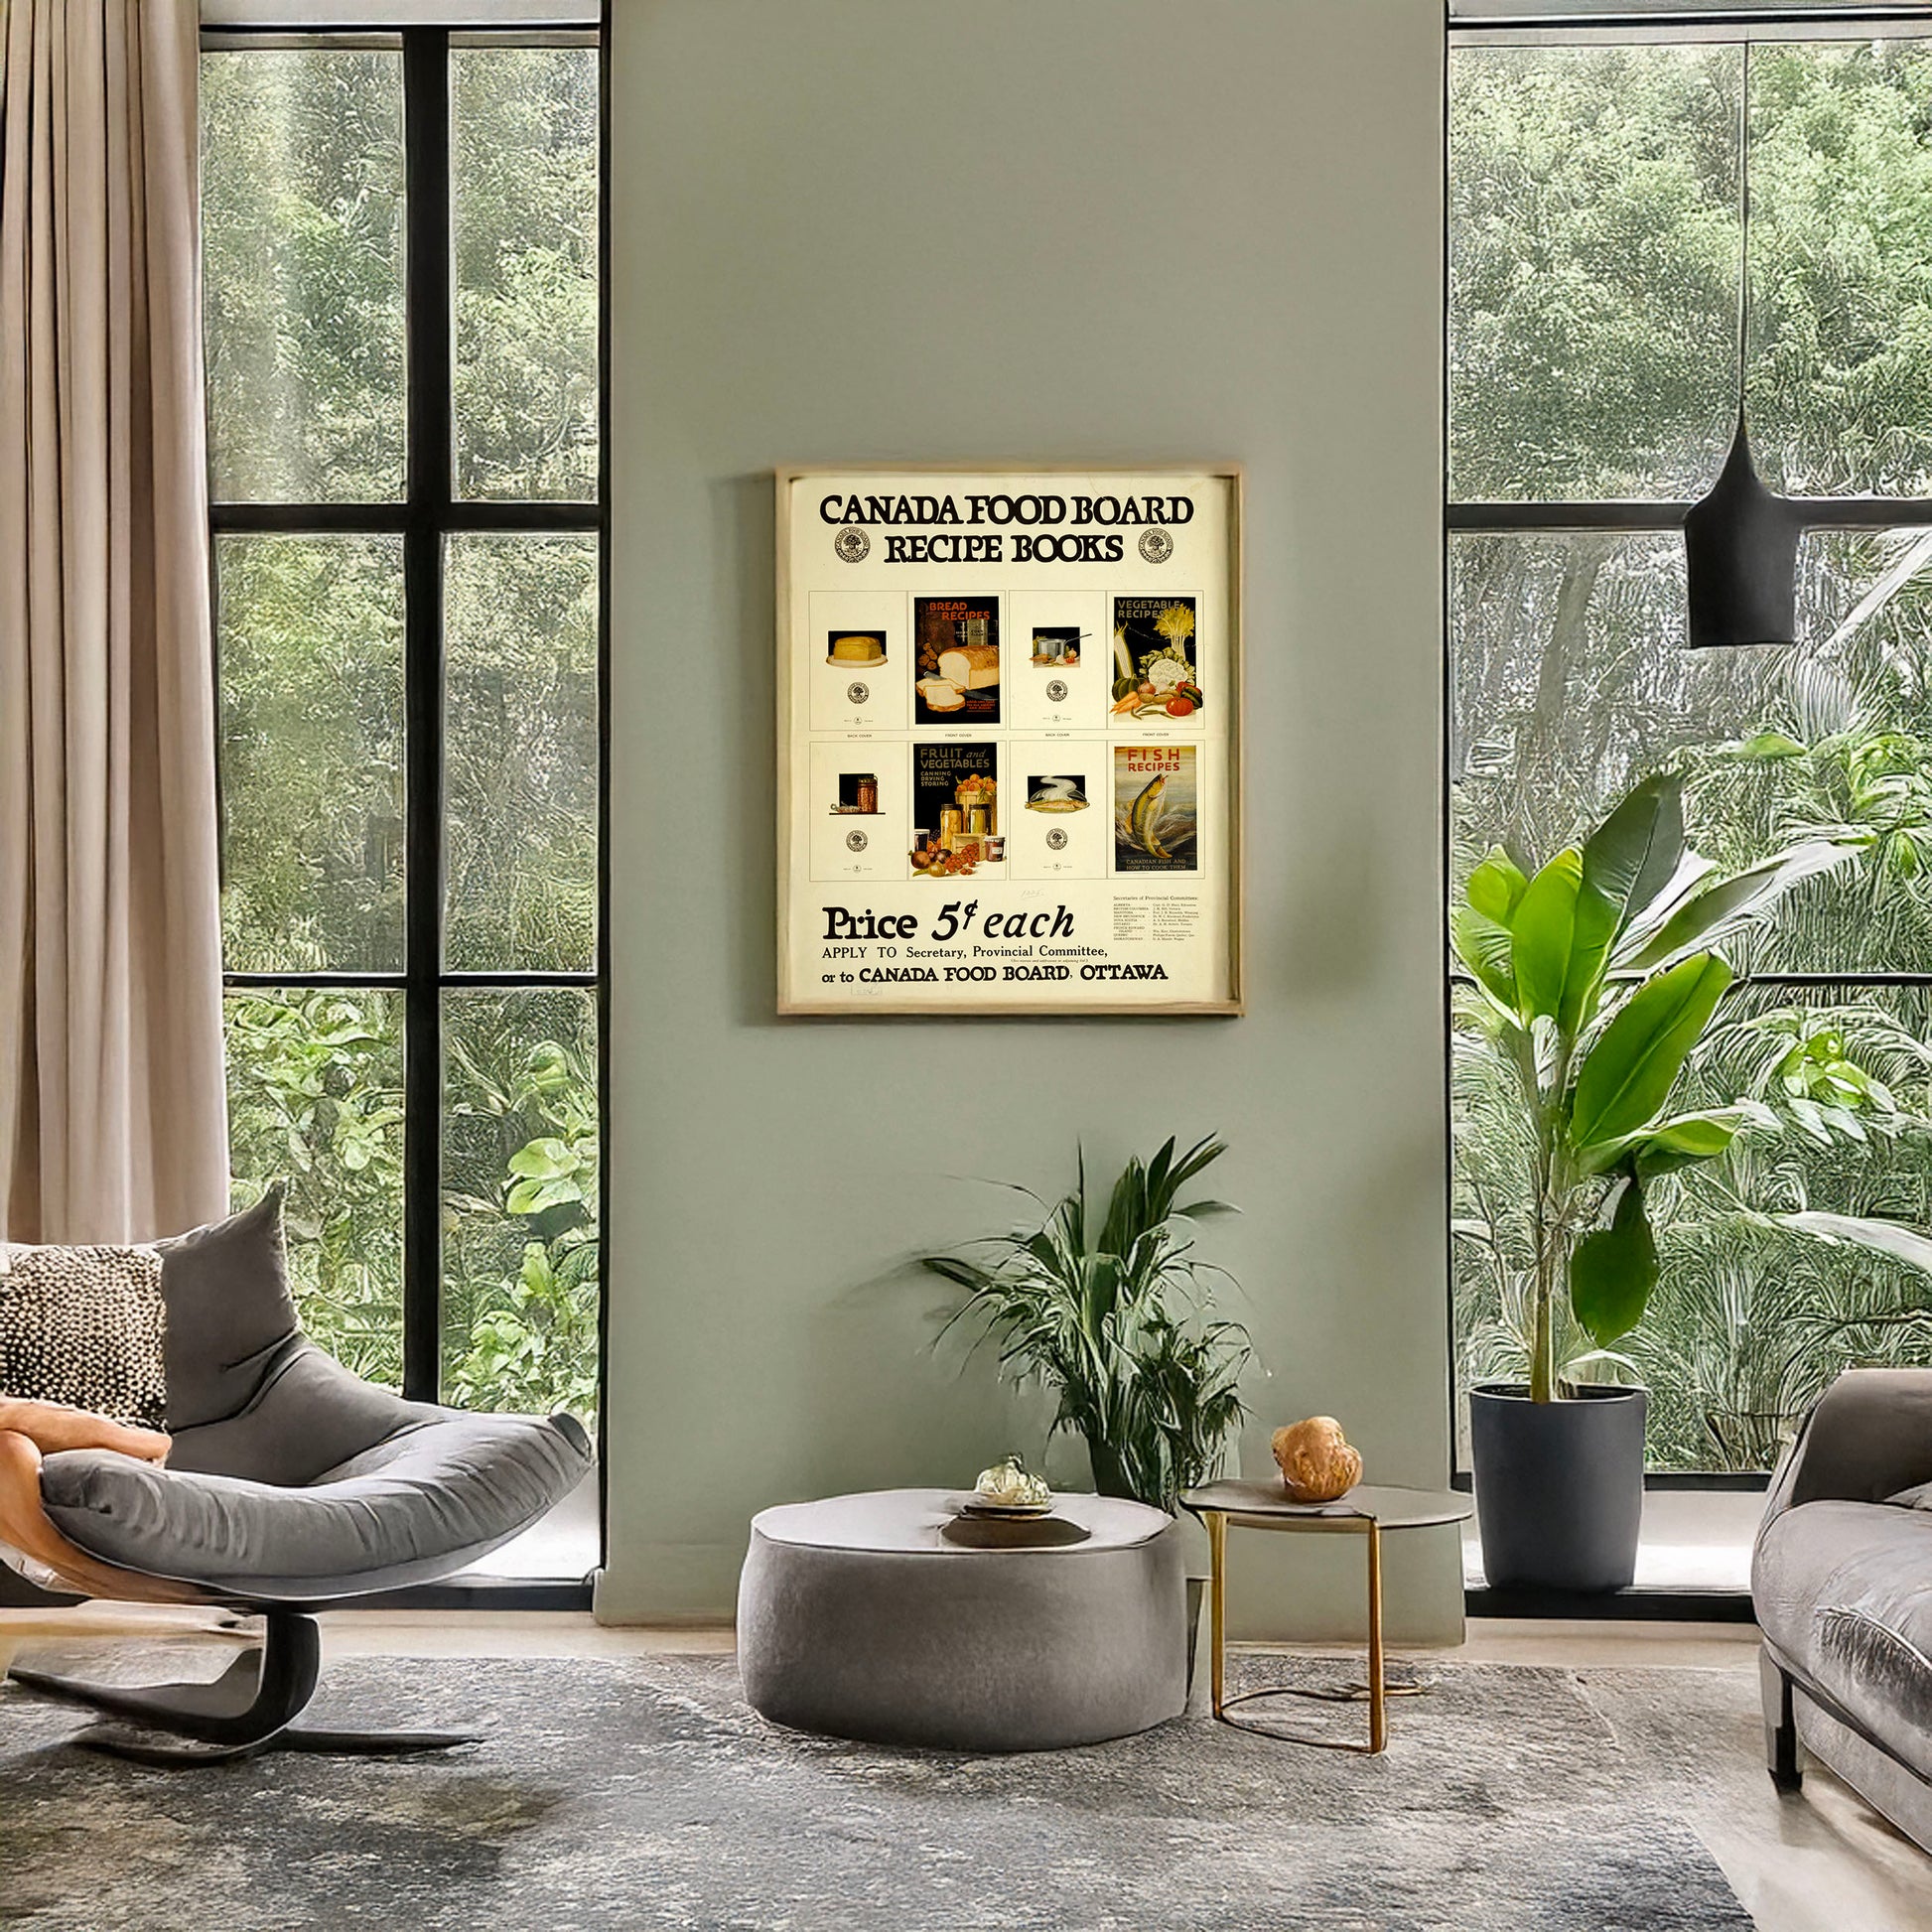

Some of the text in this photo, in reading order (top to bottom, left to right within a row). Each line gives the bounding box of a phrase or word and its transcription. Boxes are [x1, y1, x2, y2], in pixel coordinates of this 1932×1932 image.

[819, 494, 1194, 525] CANADA FOOD BOARD
[884, 533, 1124, 563] RECIPE BOOKS
[928, 602, 968, 611] BREAD
[1118, 600, 1180, 610] VEGETABLE
[941, 611, 991, 621] RECIPES
[1118, 610, 1165, 619] RECIPES
[920, 748, 986, 759] FRUIT and
[1127, 748, 1180, 761] FISH
[920, 759, 990, 768] VEGETABLES
[1128, 761, 1180, 771] RECIPES
[822, 899, 1074, 941] Price 5¢ each
[821, 944, 1108, 960] APPLY TO Secretary, Provincial Committee,
[821, 964, 1169, 983] or to CANADA FOOD BOARD, OTTAWA
